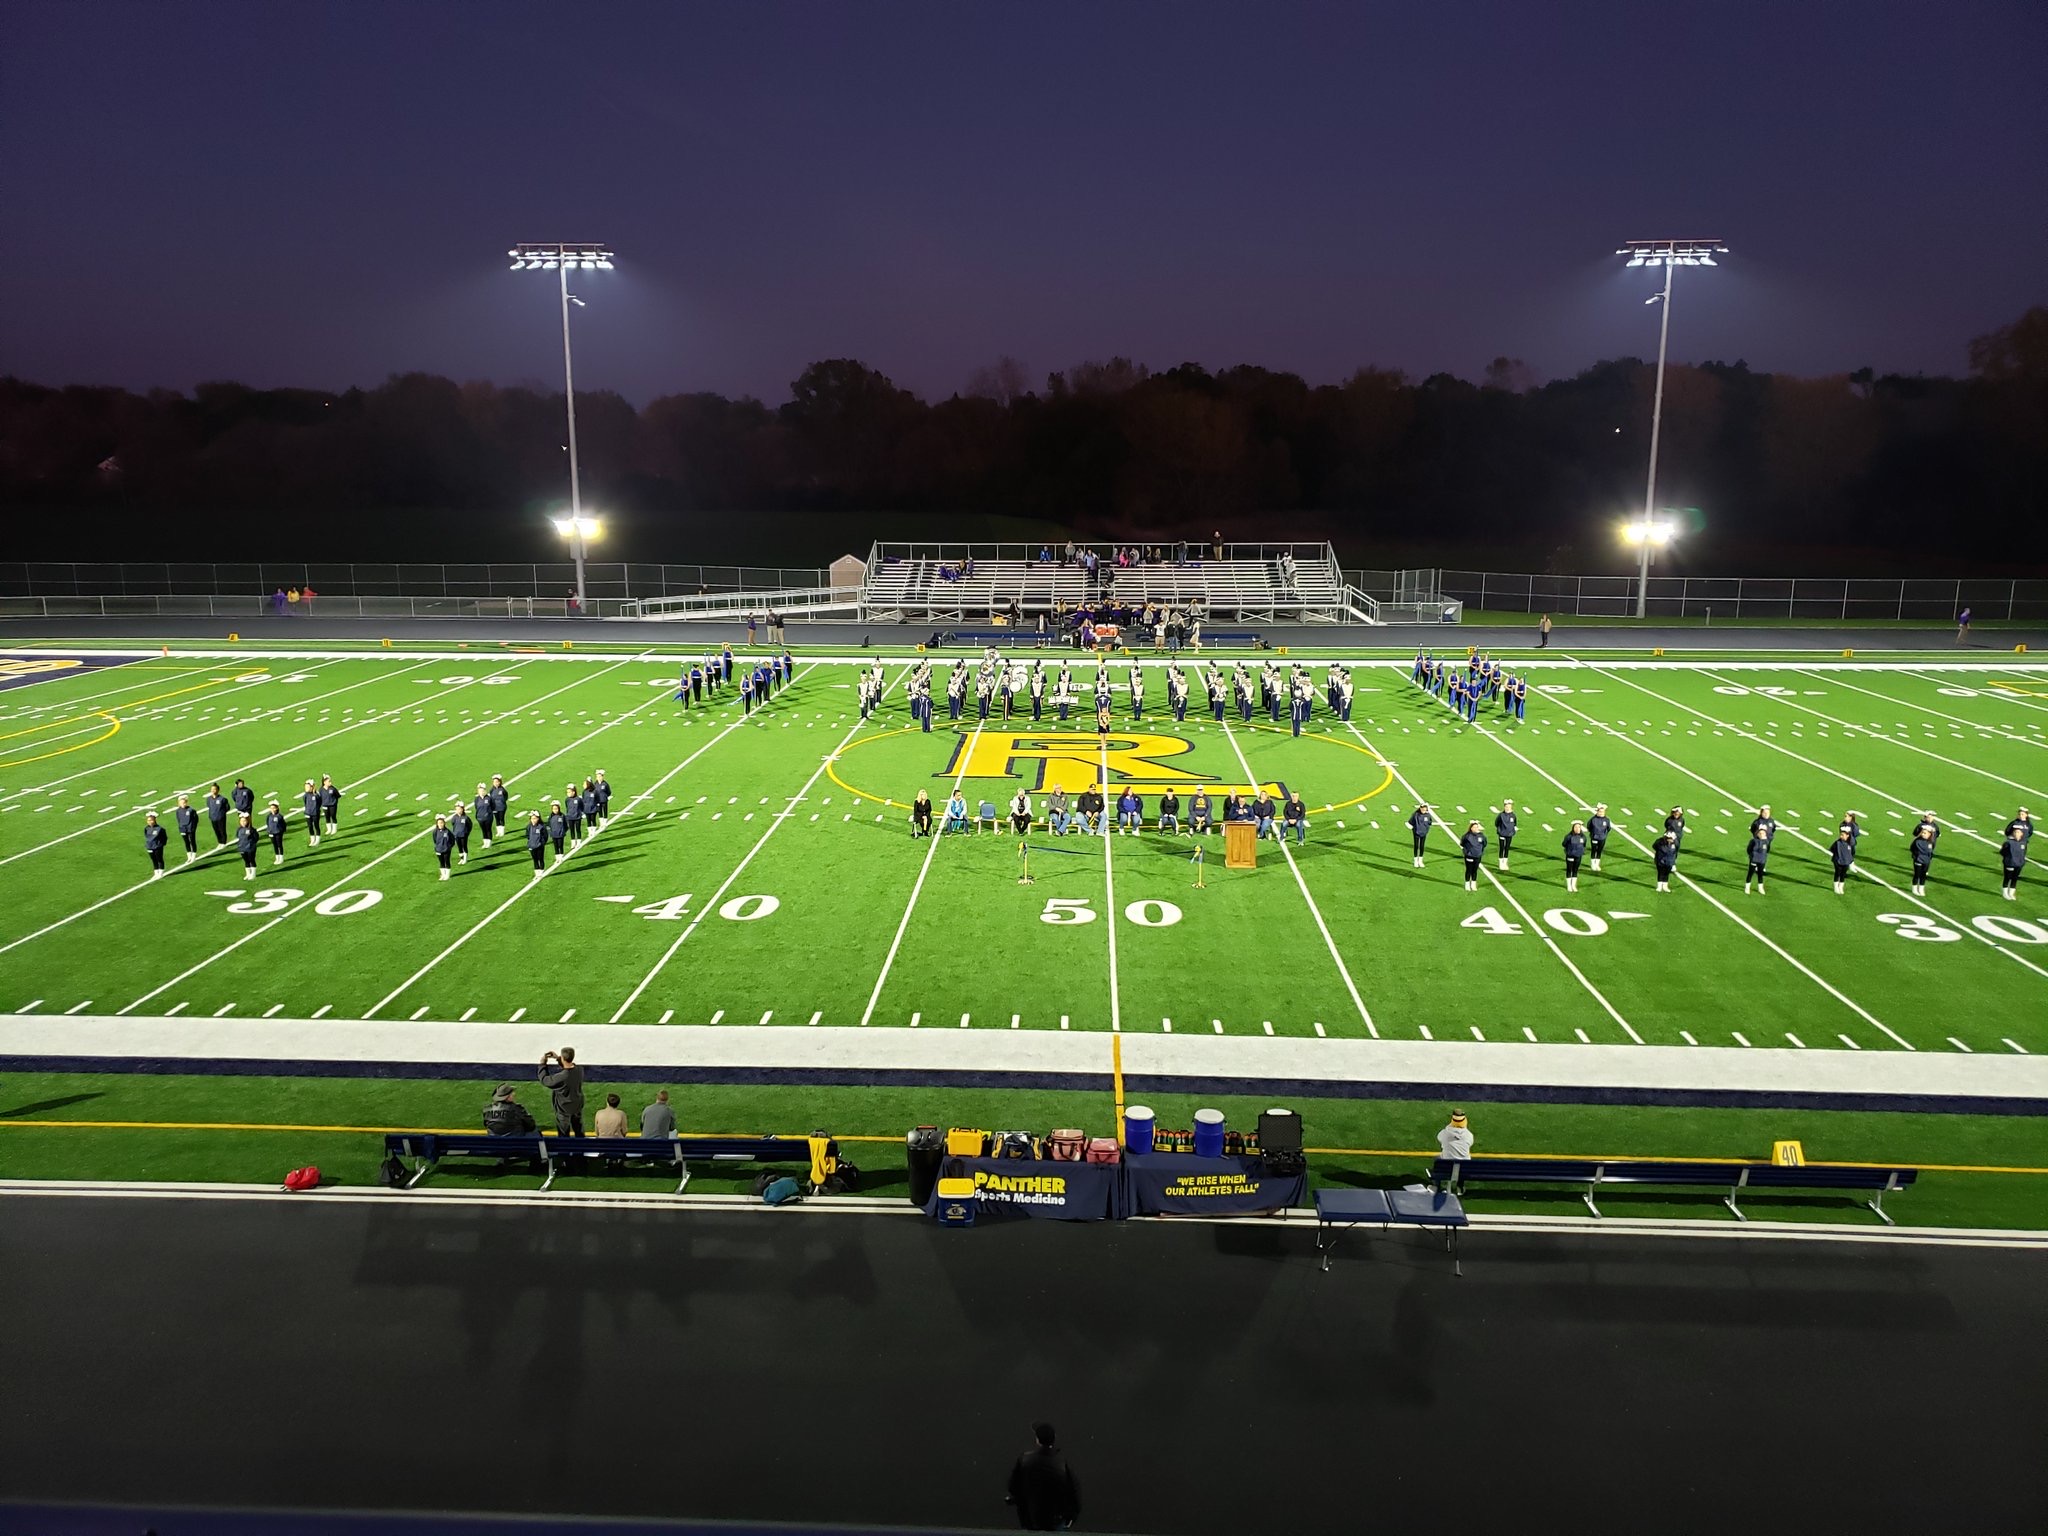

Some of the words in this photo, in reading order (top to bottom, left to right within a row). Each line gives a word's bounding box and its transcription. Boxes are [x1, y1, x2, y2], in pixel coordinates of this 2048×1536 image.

[227, 888, 383, 915] 30
[632, 893, 780, 921] 40
[1039, 898, 1183, 927] 50
[1460, 906, 1608, 936] 40
[1876, 913, 2048, 944] 30
[1782, 1145, 1799, 1166] 40
[974, 1171, 1066, 1194] PANTHER
[1165, 1187, 1185, 1196] OUR
[1186, 1185, 1232, 1196] ATHLETES
[1196, 1175, 1218, 1185] RISE
[1219, 1174, 1247, 1184] WHEN
[974, 1189, 1011, 1202] Sports
[1012, 1193, 1066, 1206] Medicine
